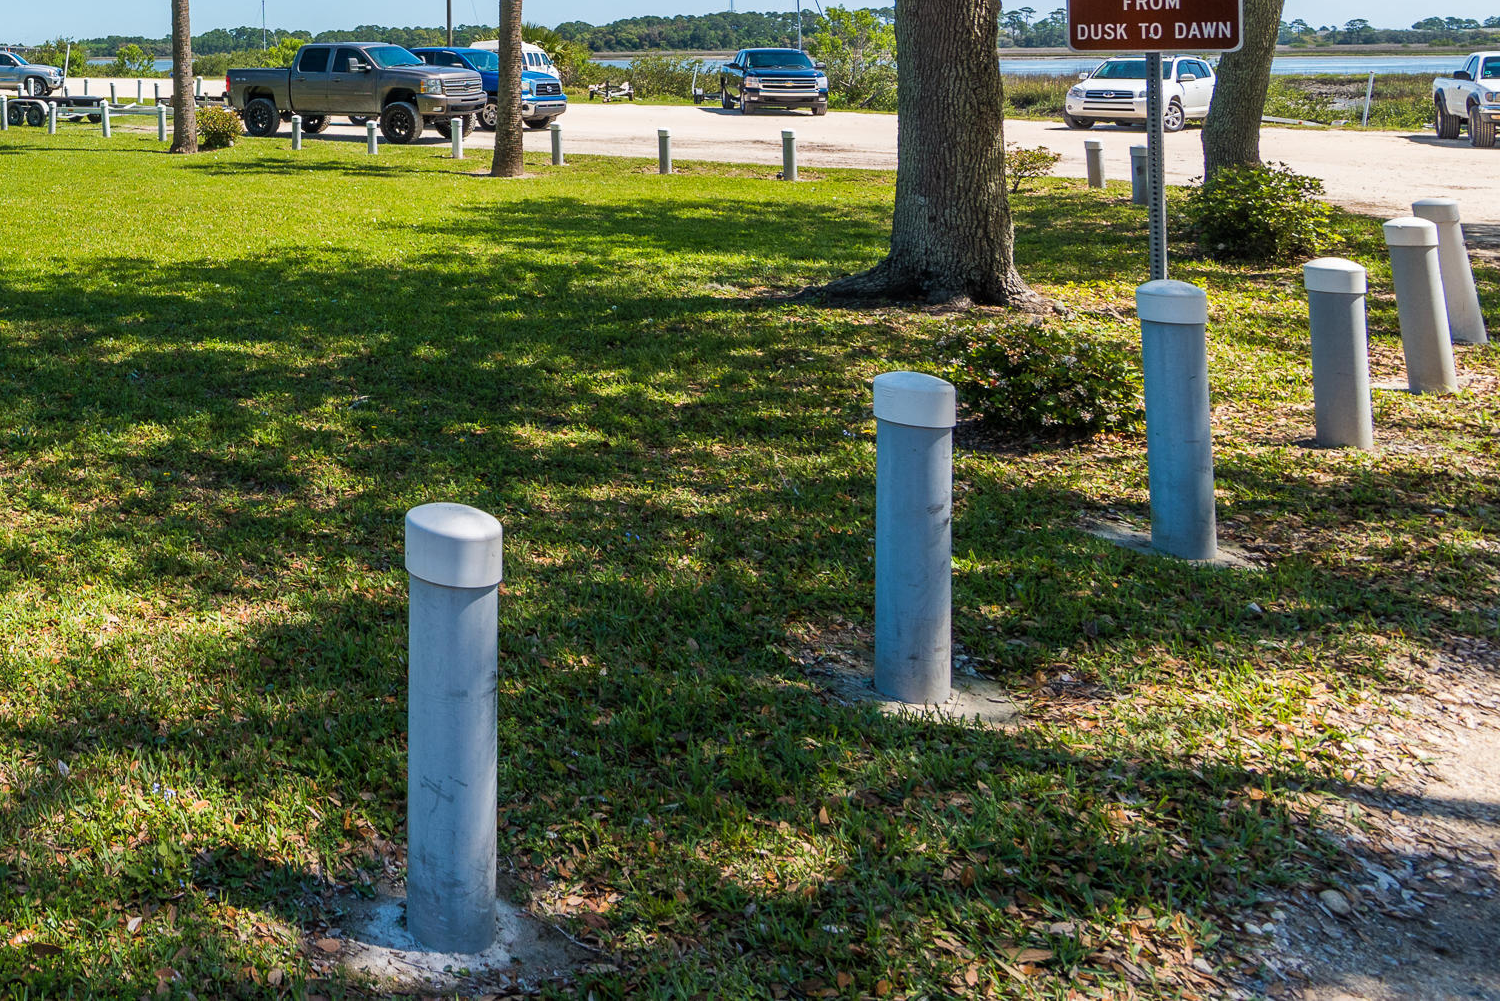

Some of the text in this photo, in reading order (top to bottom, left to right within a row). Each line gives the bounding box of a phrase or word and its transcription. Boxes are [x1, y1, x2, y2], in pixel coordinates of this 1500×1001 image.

[1077, 22, 1231, 40] DUSK TO DAWN
